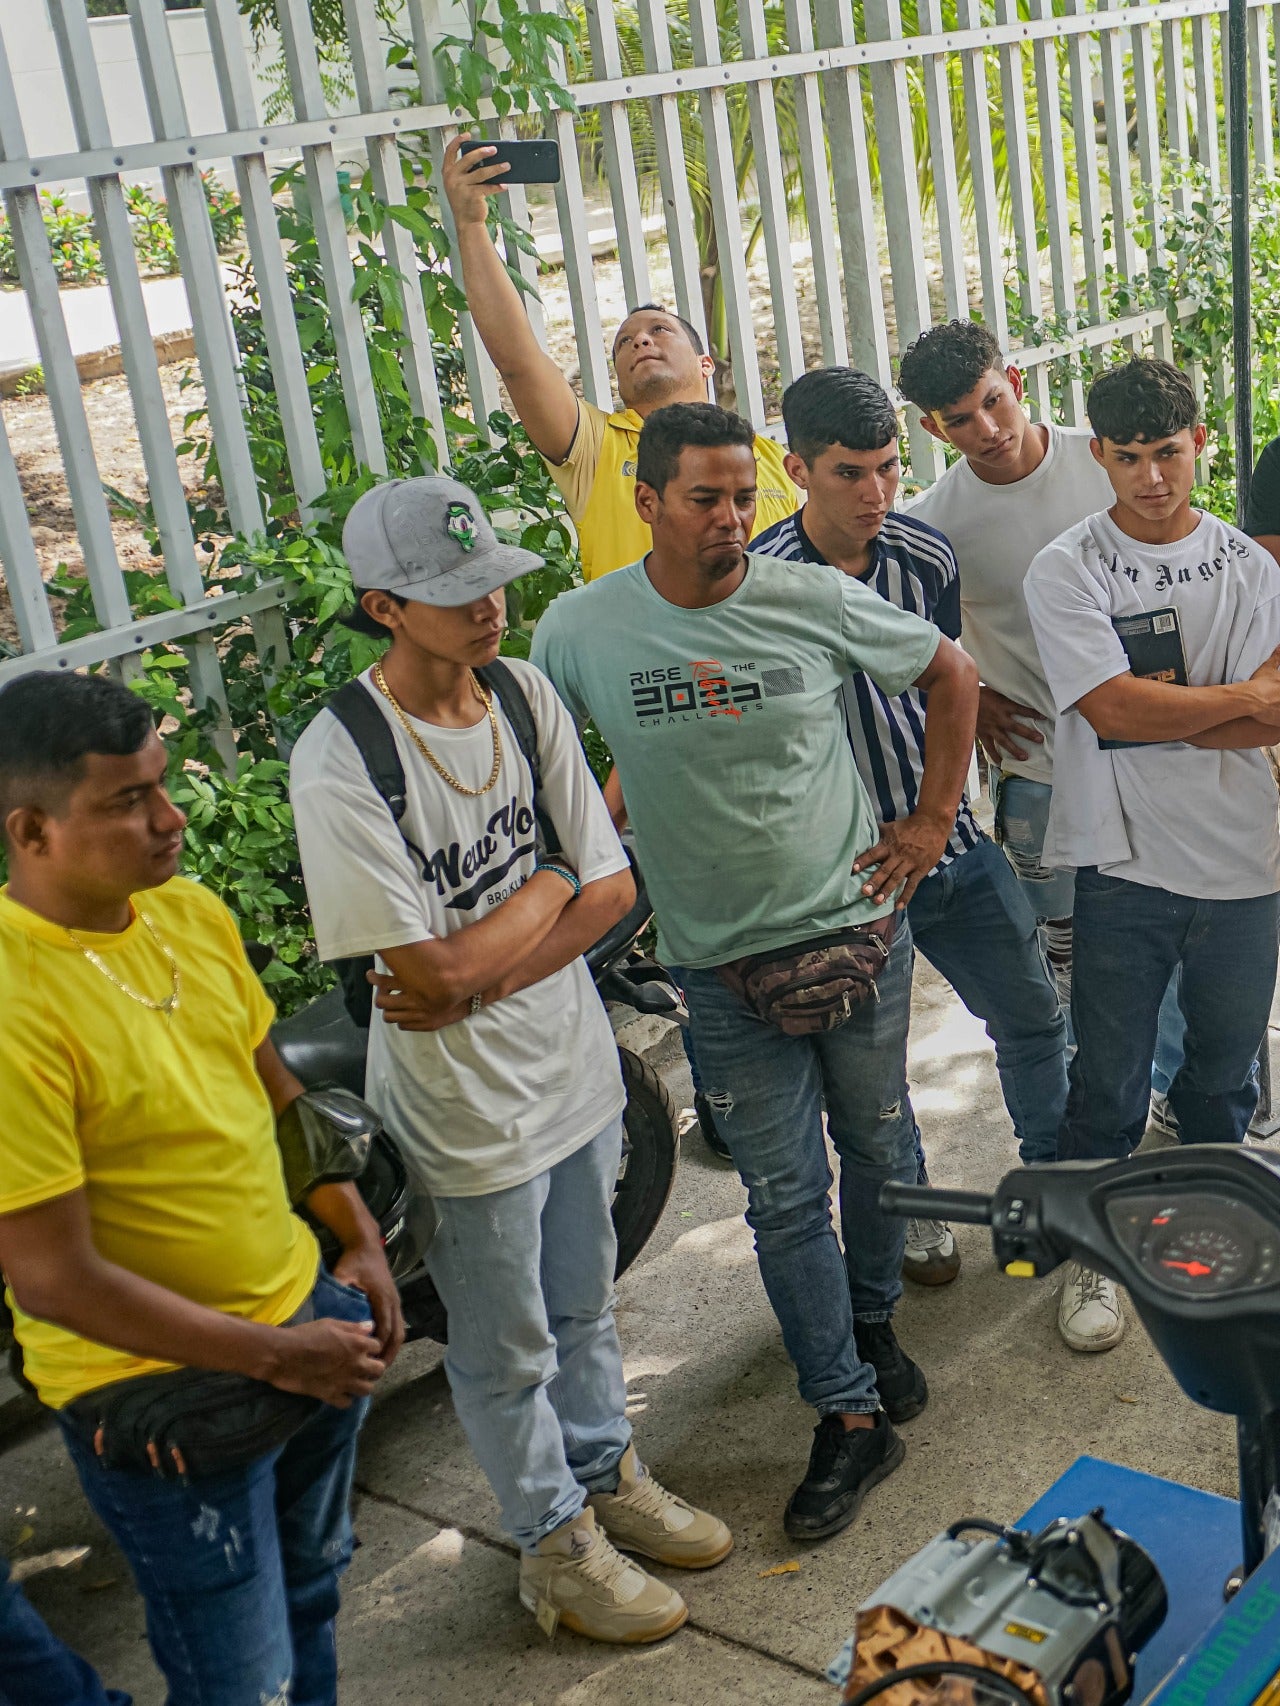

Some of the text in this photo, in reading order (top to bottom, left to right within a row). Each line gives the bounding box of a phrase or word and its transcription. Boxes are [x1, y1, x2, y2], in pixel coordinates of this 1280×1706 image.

[629, 662, 756, 687] RISE THE
[422, 834, 497, 896] New
